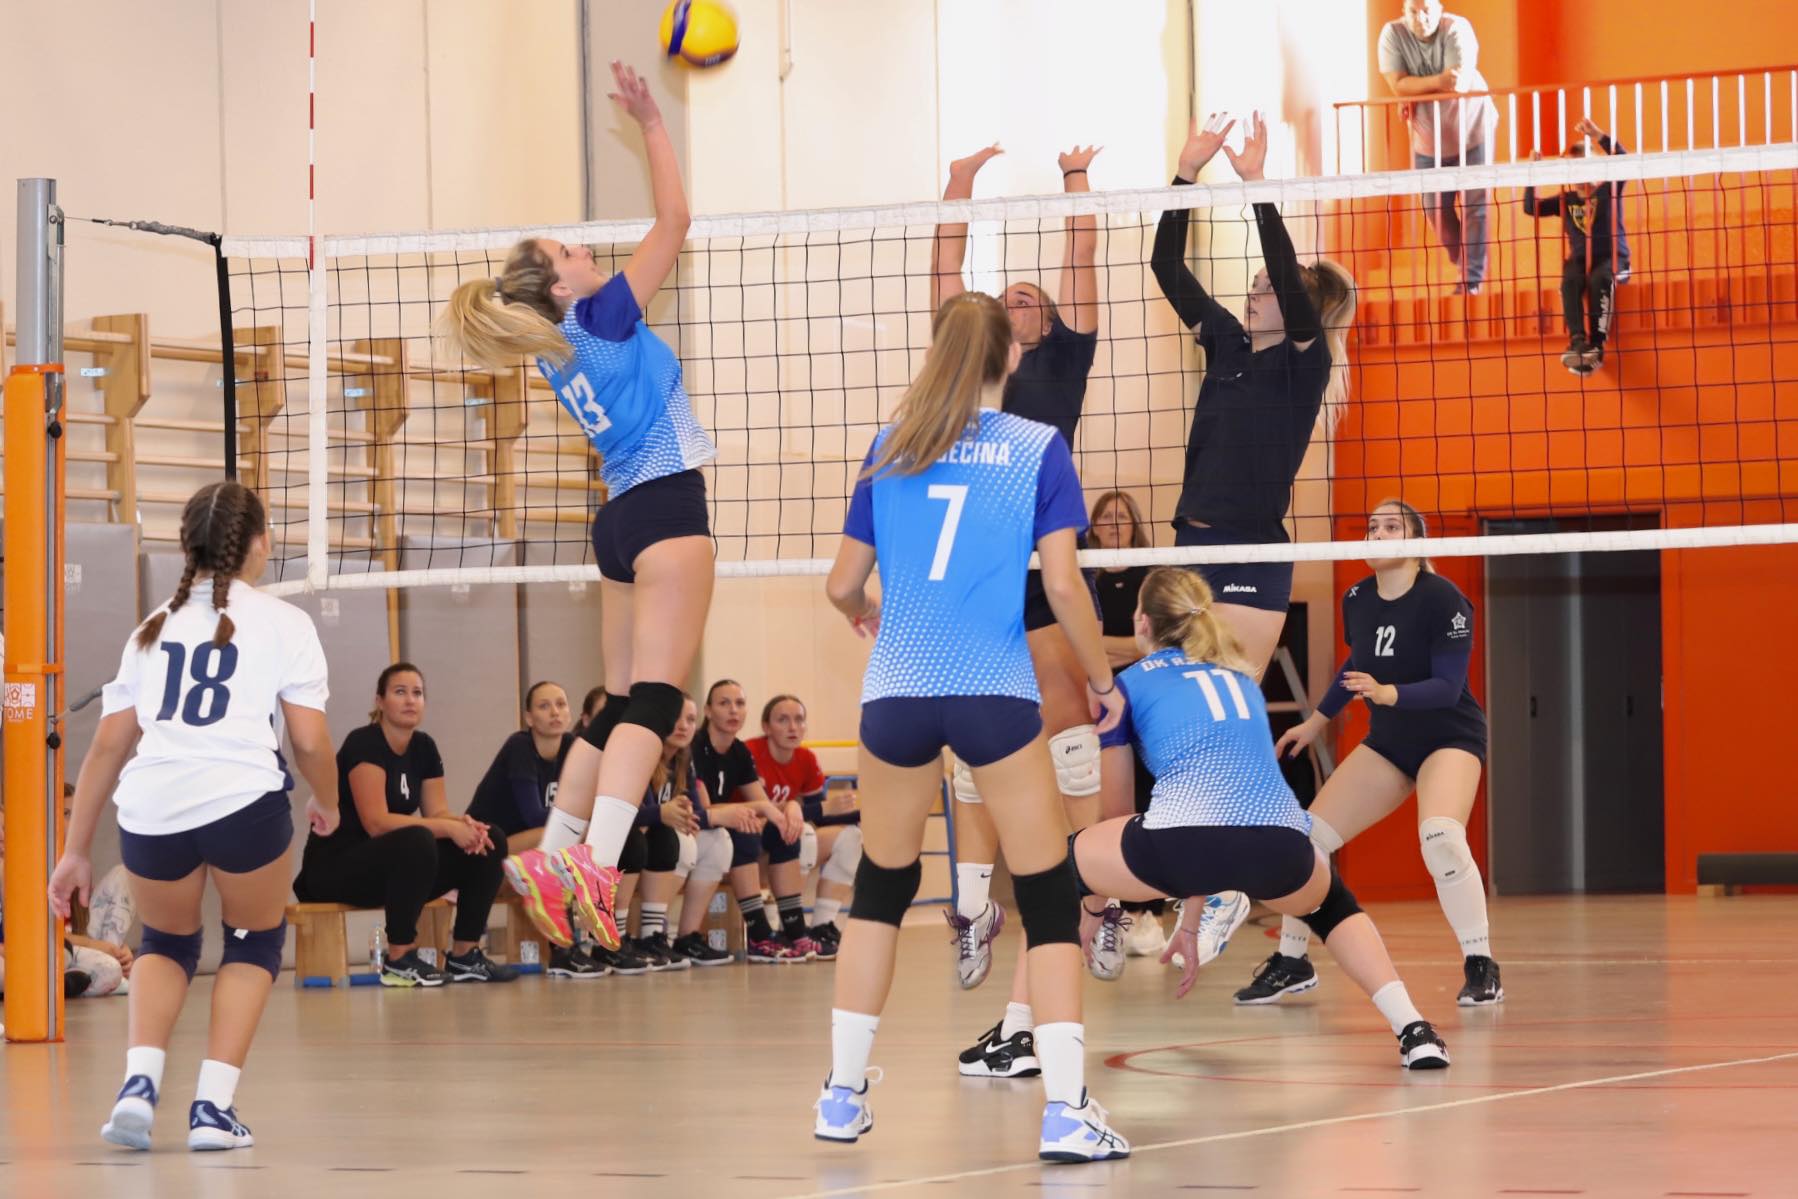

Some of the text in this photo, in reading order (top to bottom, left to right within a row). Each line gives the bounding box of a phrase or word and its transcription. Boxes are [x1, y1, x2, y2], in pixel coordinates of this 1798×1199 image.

[560, 372, 613, 439] 13
[927, 484, 969, 581] 7
[1375, 625, 1396, 657] 12
[155, 640, 239, 727] 18
[1182, 668, 1251, 722] 11
[400, 773, 410, 800] 4
[718, 771, 725, 796] 1
